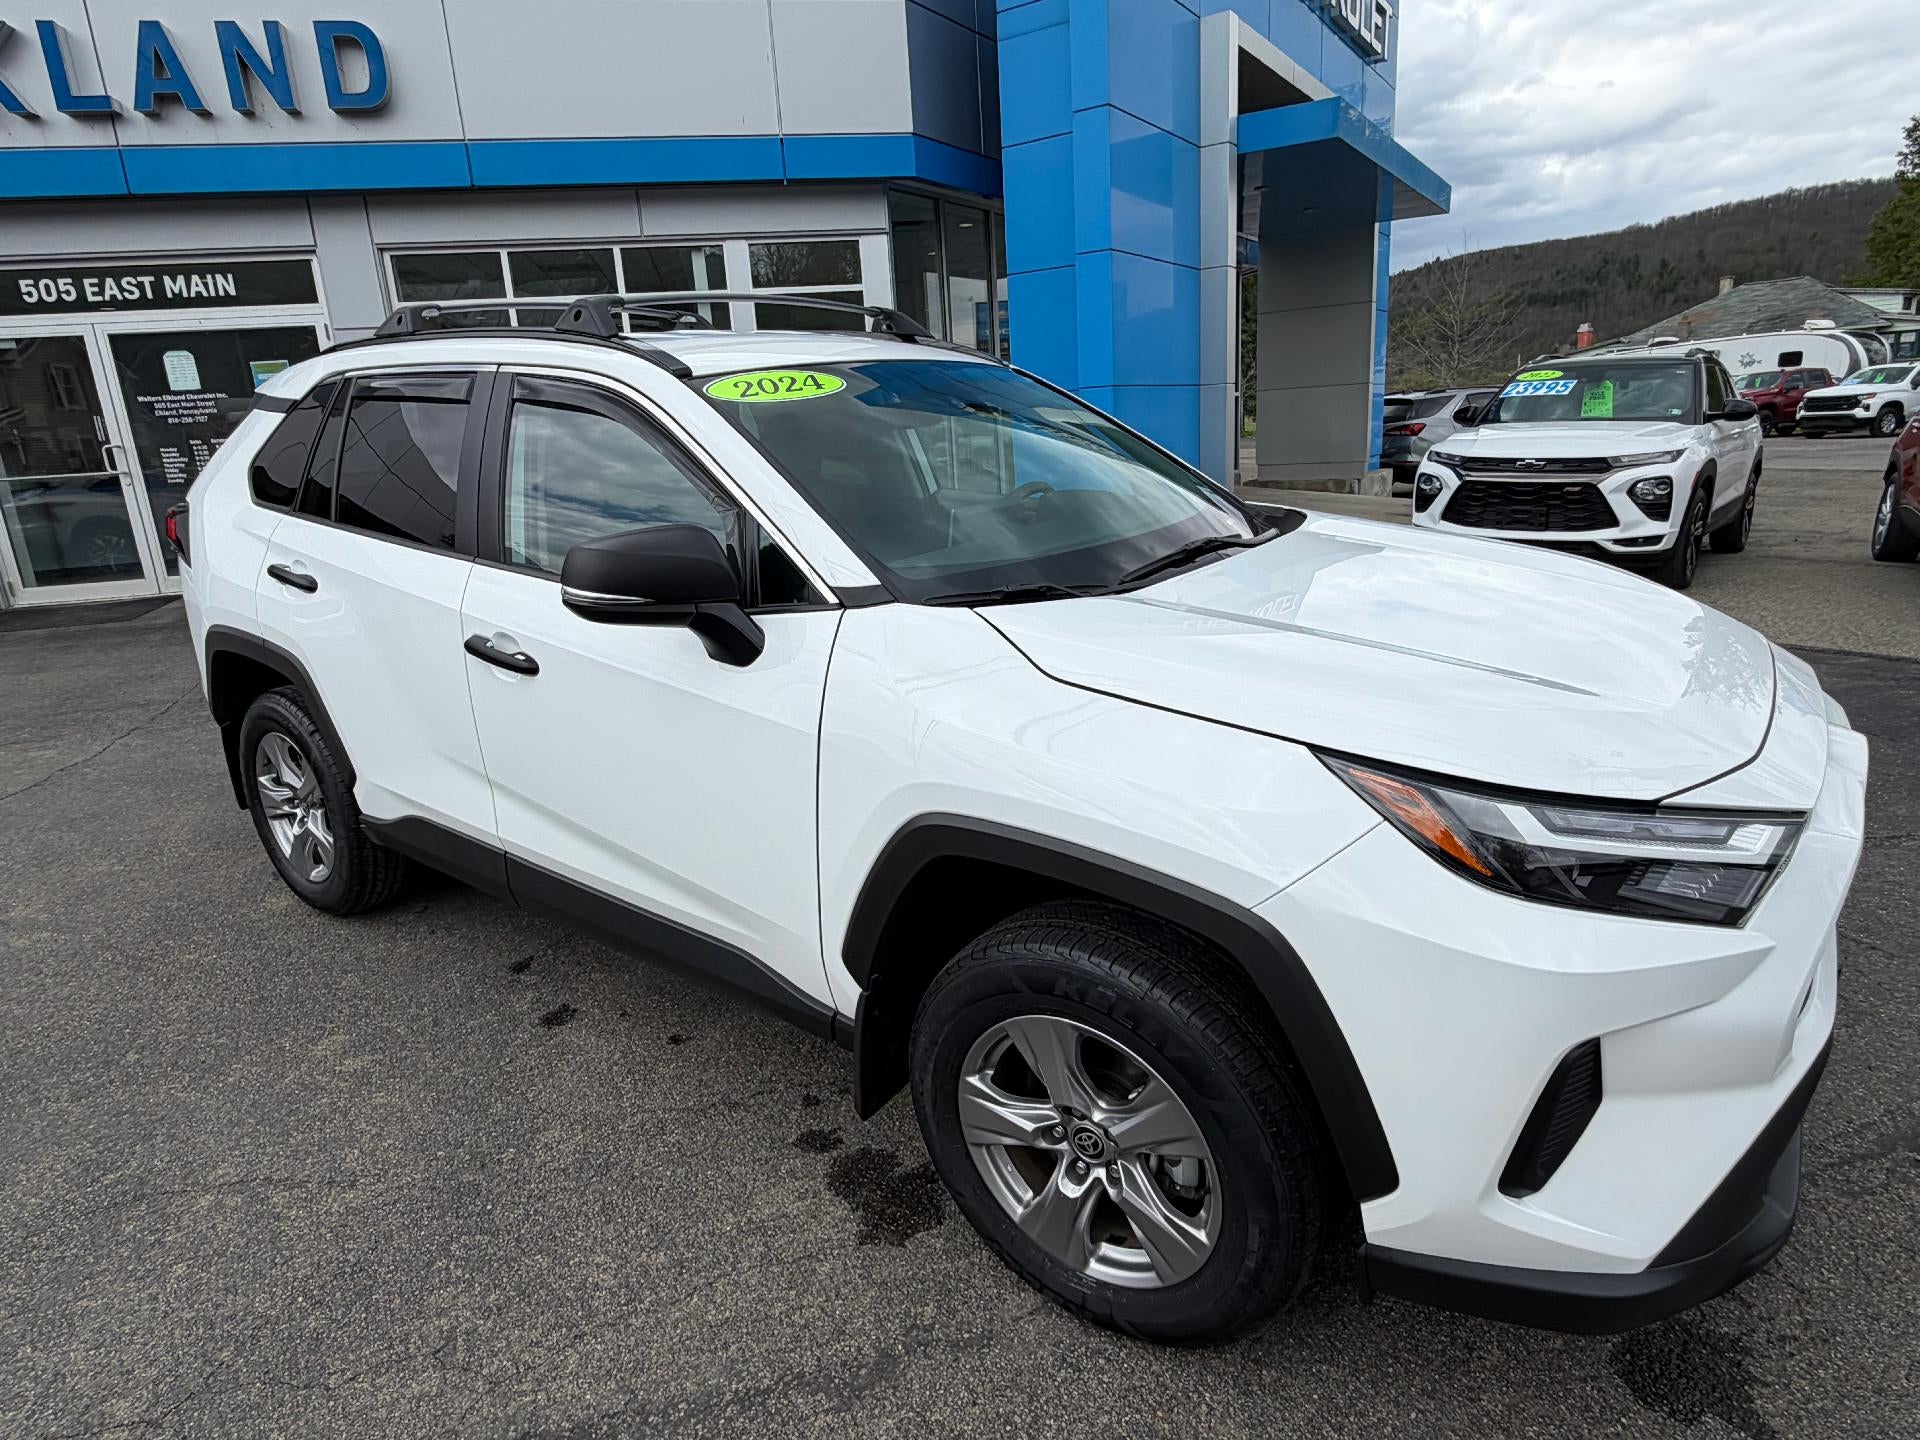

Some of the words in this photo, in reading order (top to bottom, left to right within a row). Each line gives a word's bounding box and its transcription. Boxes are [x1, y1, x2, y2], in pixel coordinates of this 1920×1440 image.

[18, 278, 77, 304] 505
[83, 275, 155, 302] EAST
[163, 273, 237, 299] MAIN
[733, 374, 825, 398] 2024
[1505, 380, 1575, 396] 23995
[186, 392, 216, 400] Chevrolet
[179, 407, 218, 415] Pennsylvania
